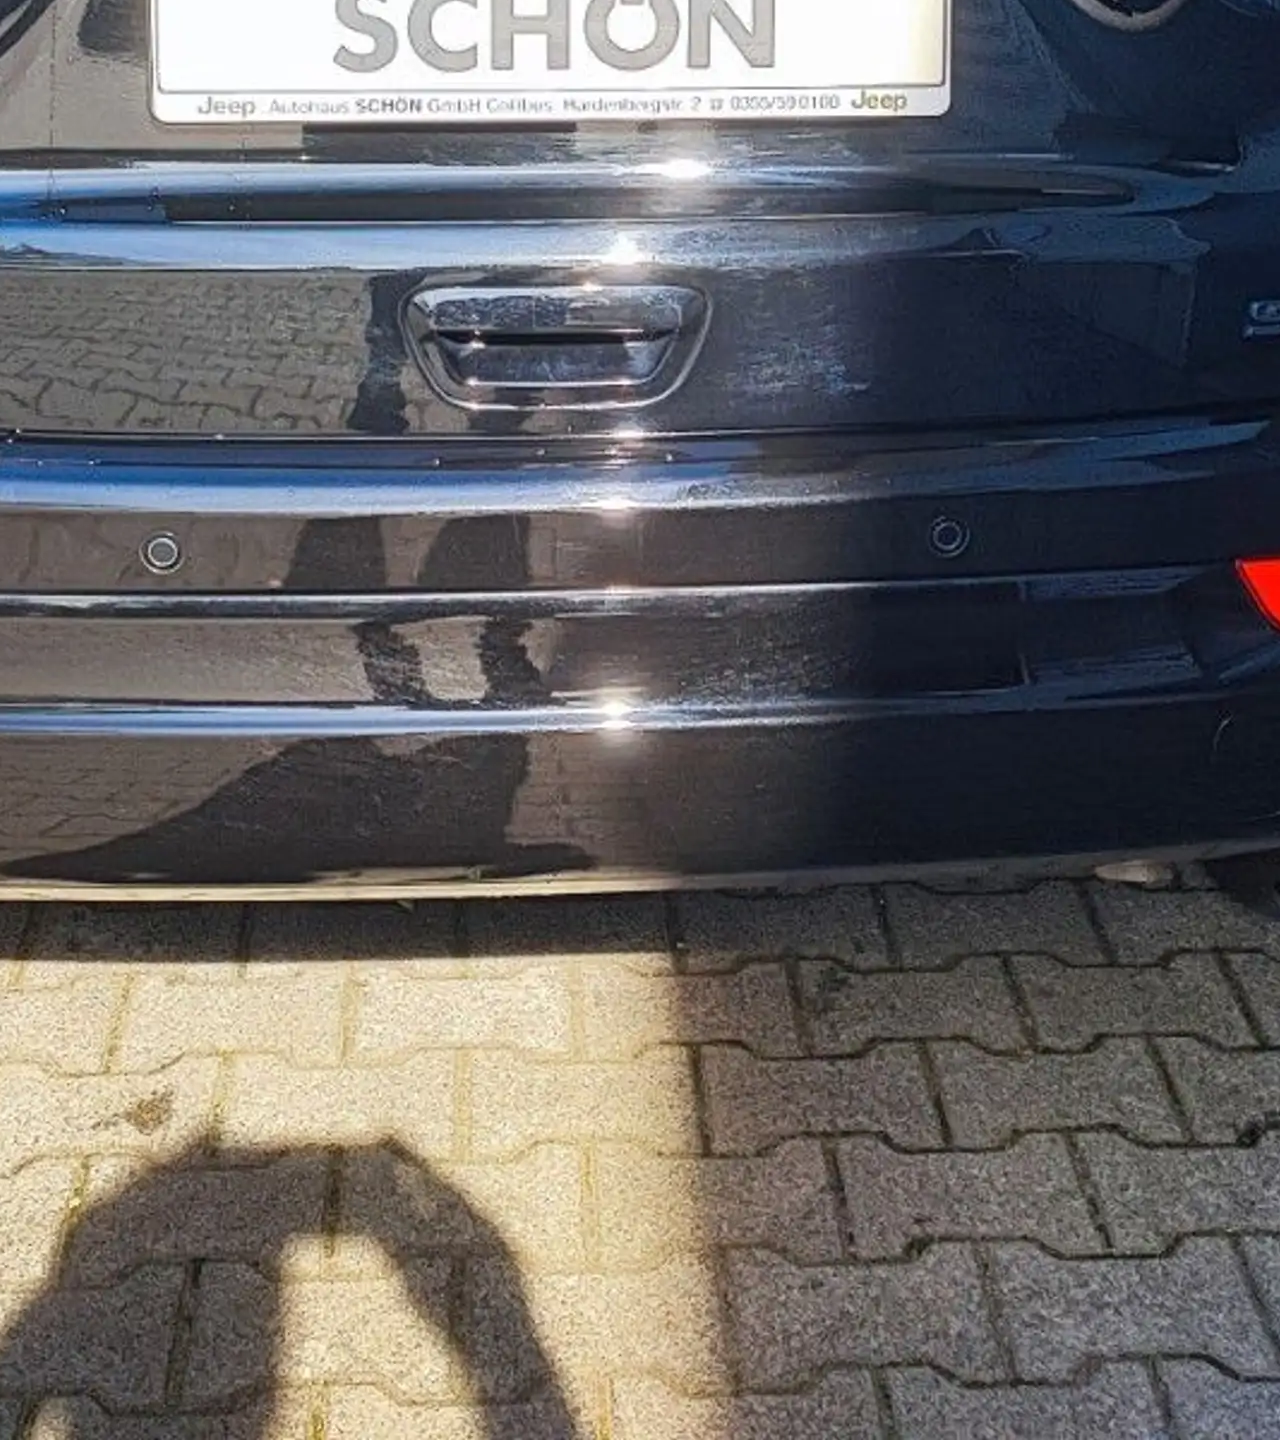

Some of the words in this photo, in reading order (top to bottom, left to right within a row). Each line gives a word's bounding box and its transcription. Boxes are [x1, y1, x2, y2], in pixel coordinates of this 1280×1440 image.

[197, 96, 256, 117] Jeep
[269, 97, 350, 114] Autohaus
[354, 95, 422, 114] SCHÖN
[427, 98, 481, 113] GmbH
[850, 90, 908, 112] Jeep
